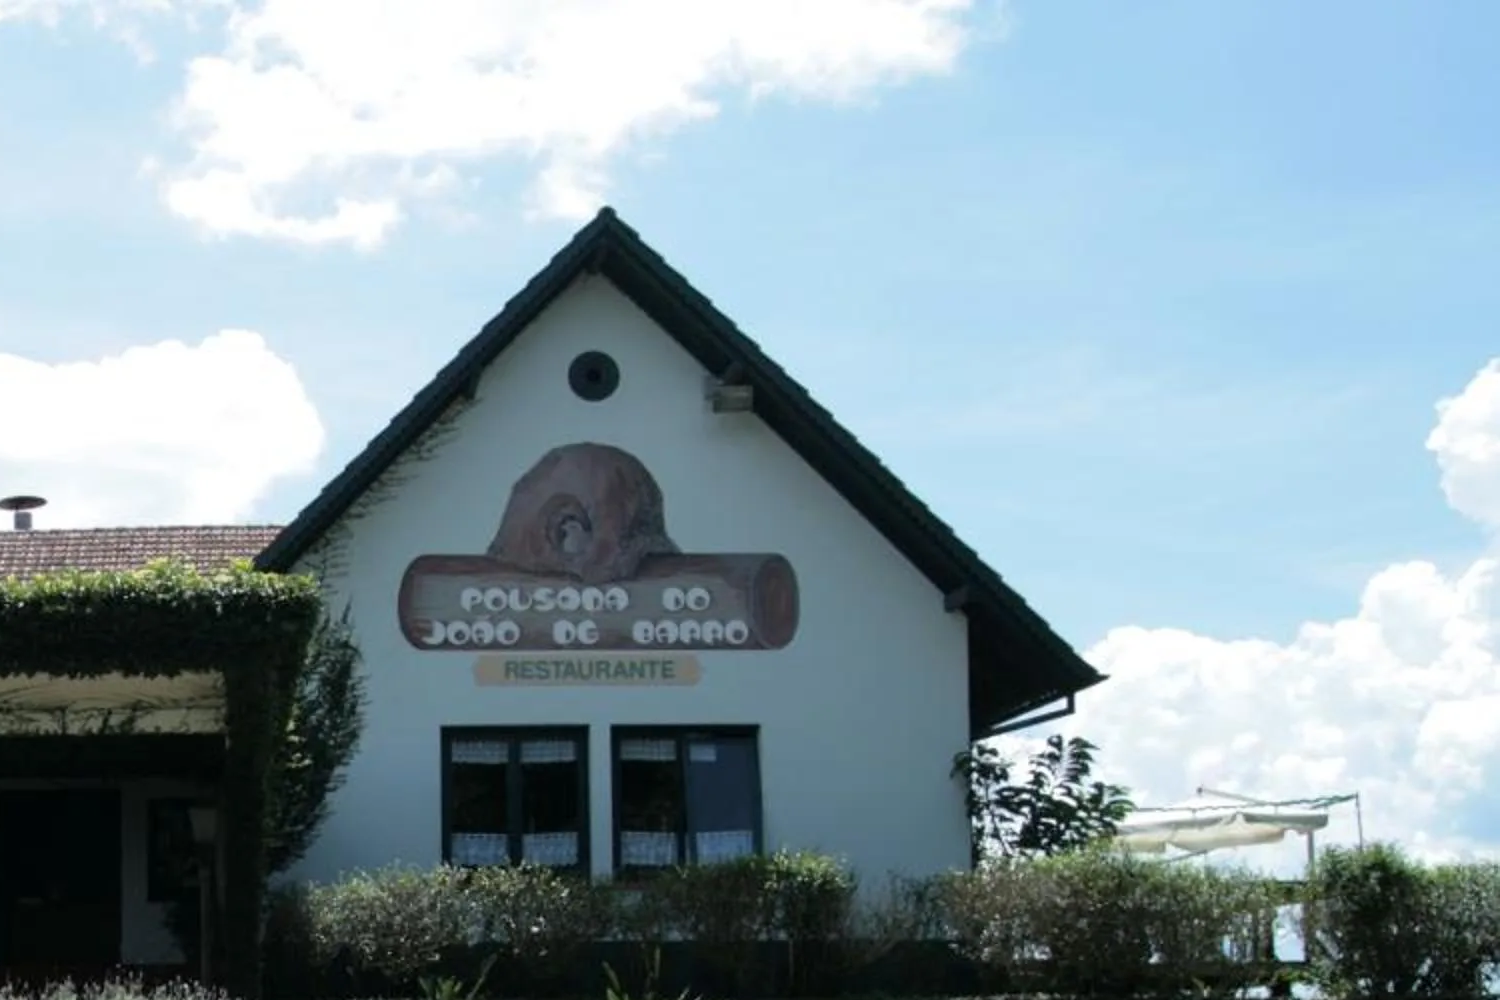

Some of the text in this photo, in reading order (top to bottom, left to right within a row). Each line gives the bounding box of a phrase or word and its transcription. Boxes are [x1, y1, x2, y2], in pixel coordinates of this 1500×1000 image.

[460, 586, 711, 613] POUSADA DO
[421, 614, 749, 645] JOÃO DE BARRO
[504, 660, 676, 680] RESTAURANTE
